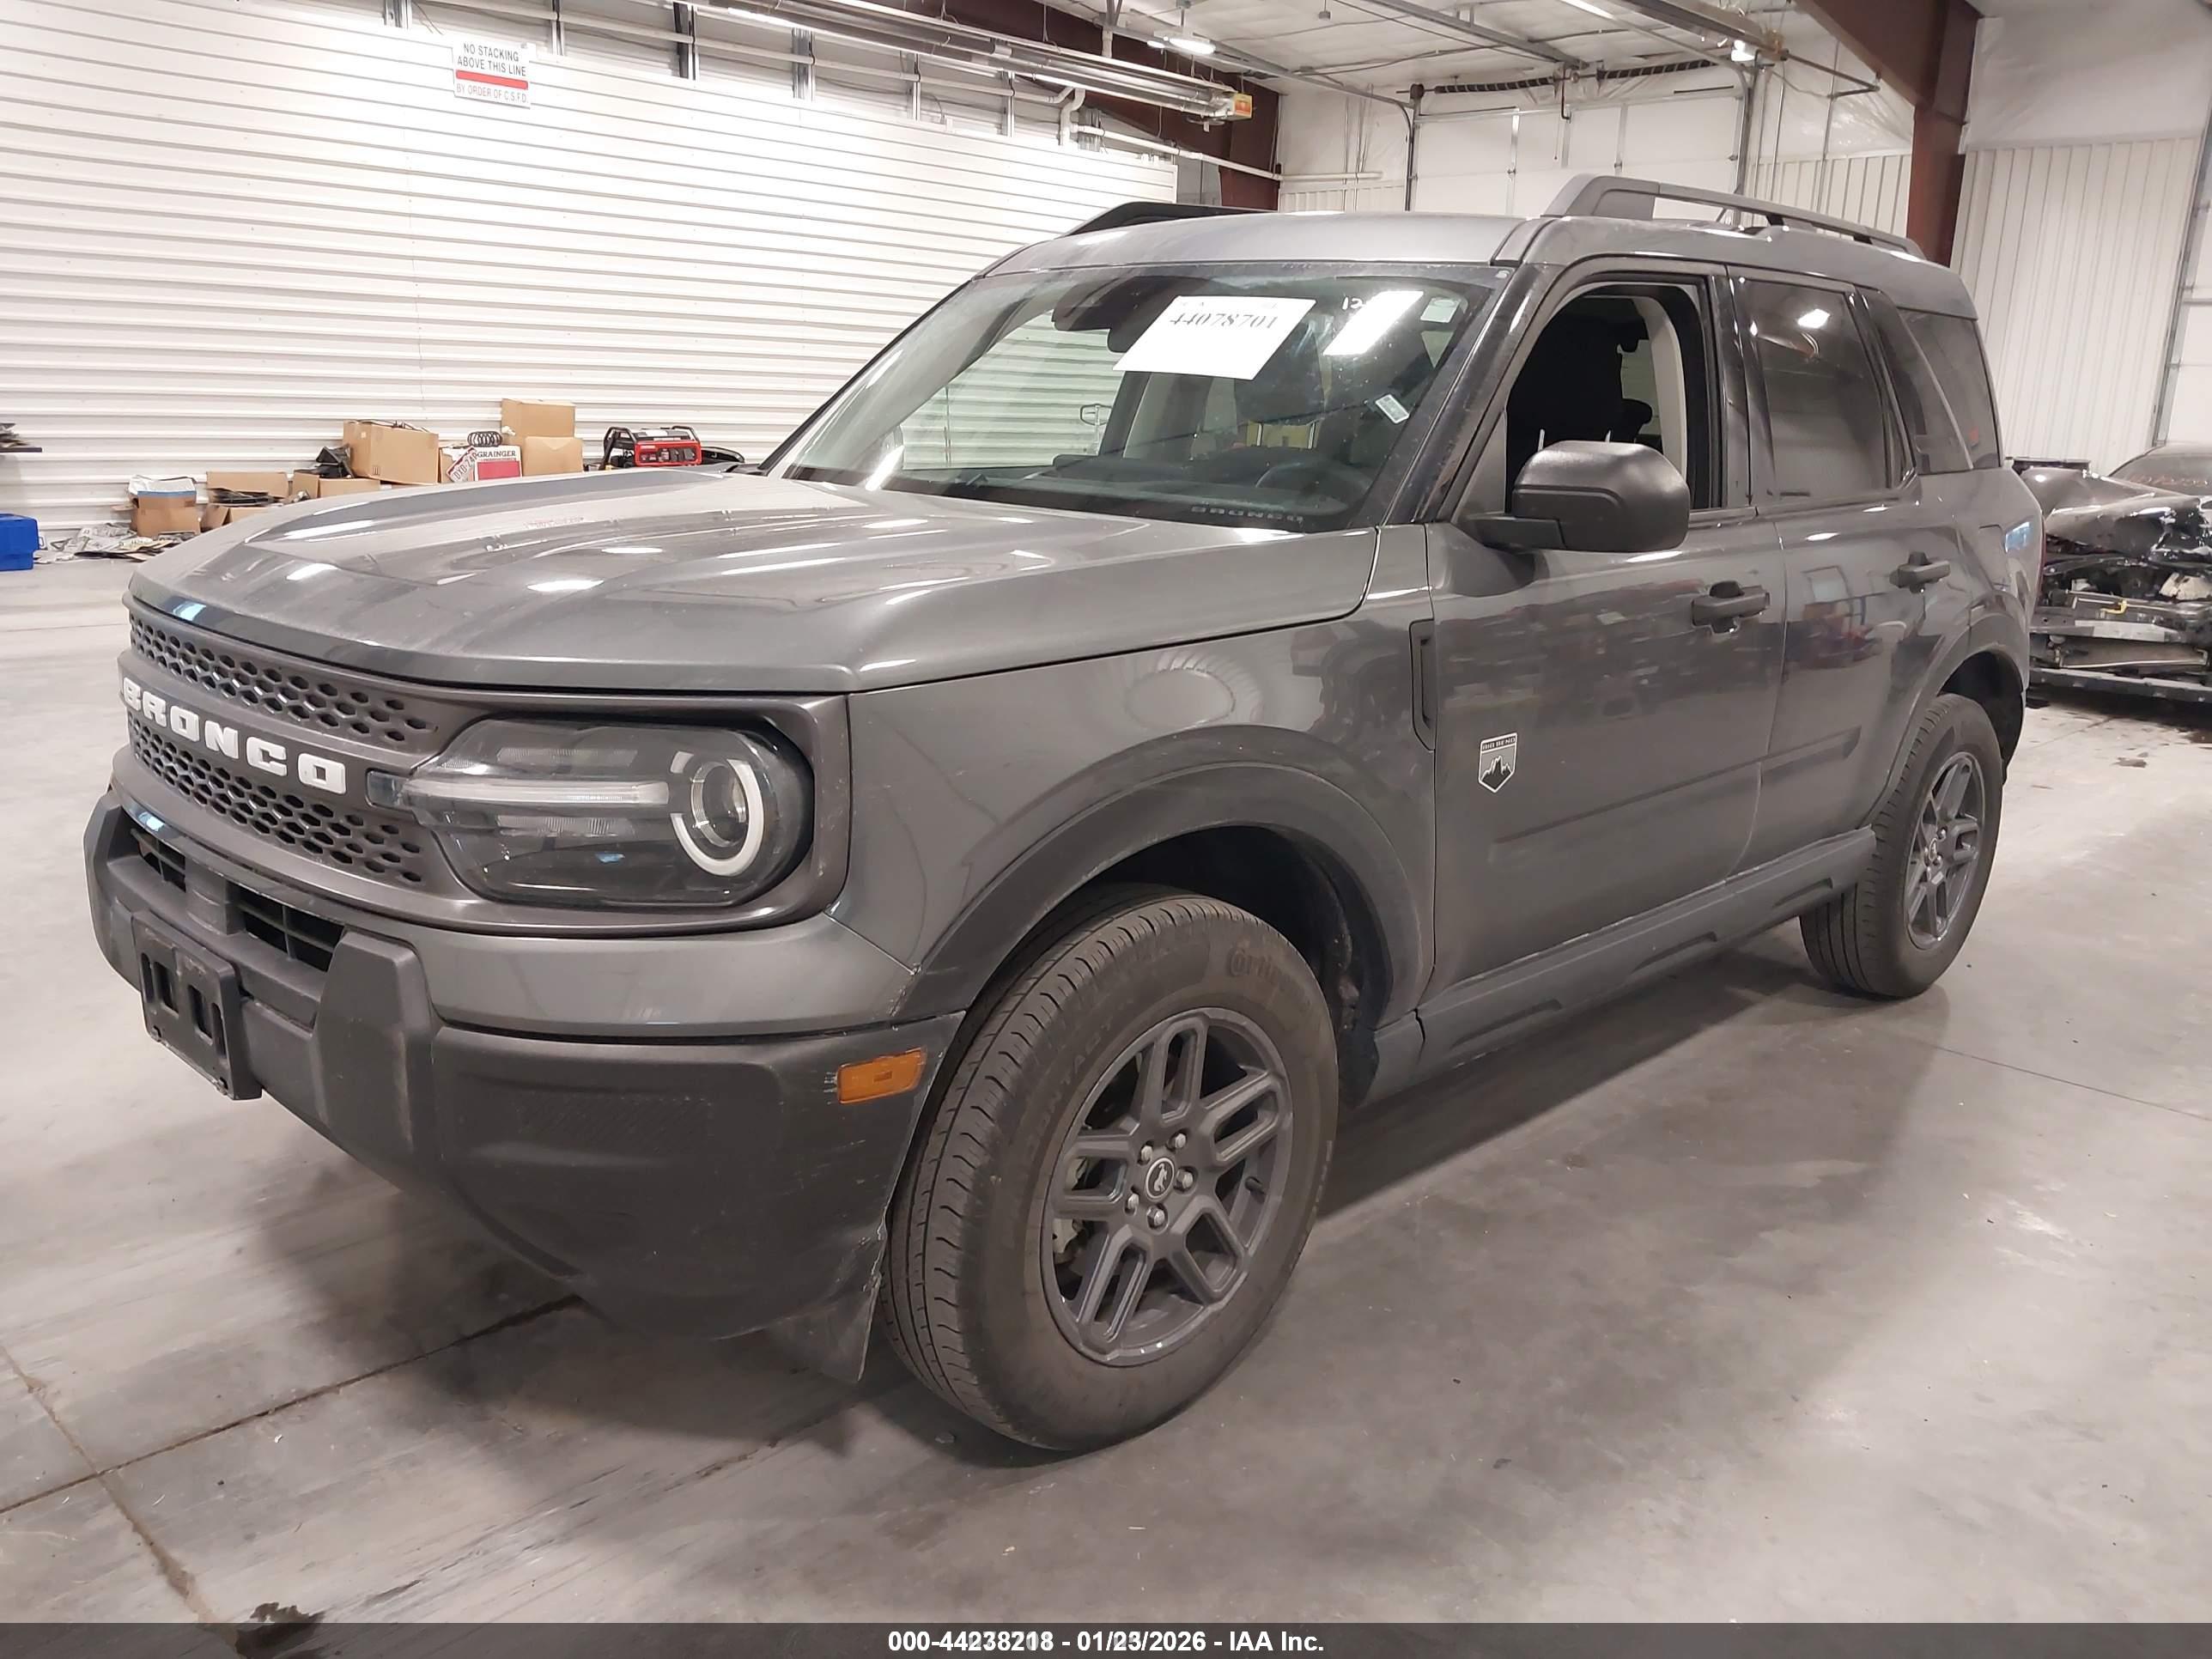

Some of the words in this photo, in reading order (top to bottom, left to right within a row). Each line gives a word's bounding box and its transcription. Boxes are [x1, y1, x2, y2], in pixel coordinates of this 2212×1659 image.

[464, 43, 476, 55] NO
[478, 46, 519, 63] STACKING
[458, 56, 485, 70] ABOVE
[489, 60, 506, 74] THIS
[508, 64, 526, 76] LINE
[456, 83, 465, 94] BY
[467, 85, 491, 98] ORDER
[494, 88, 502, 99] OF
[1170, 312, 1278, 329] 44078701
[123, 677, 346, 794] BRONCO
